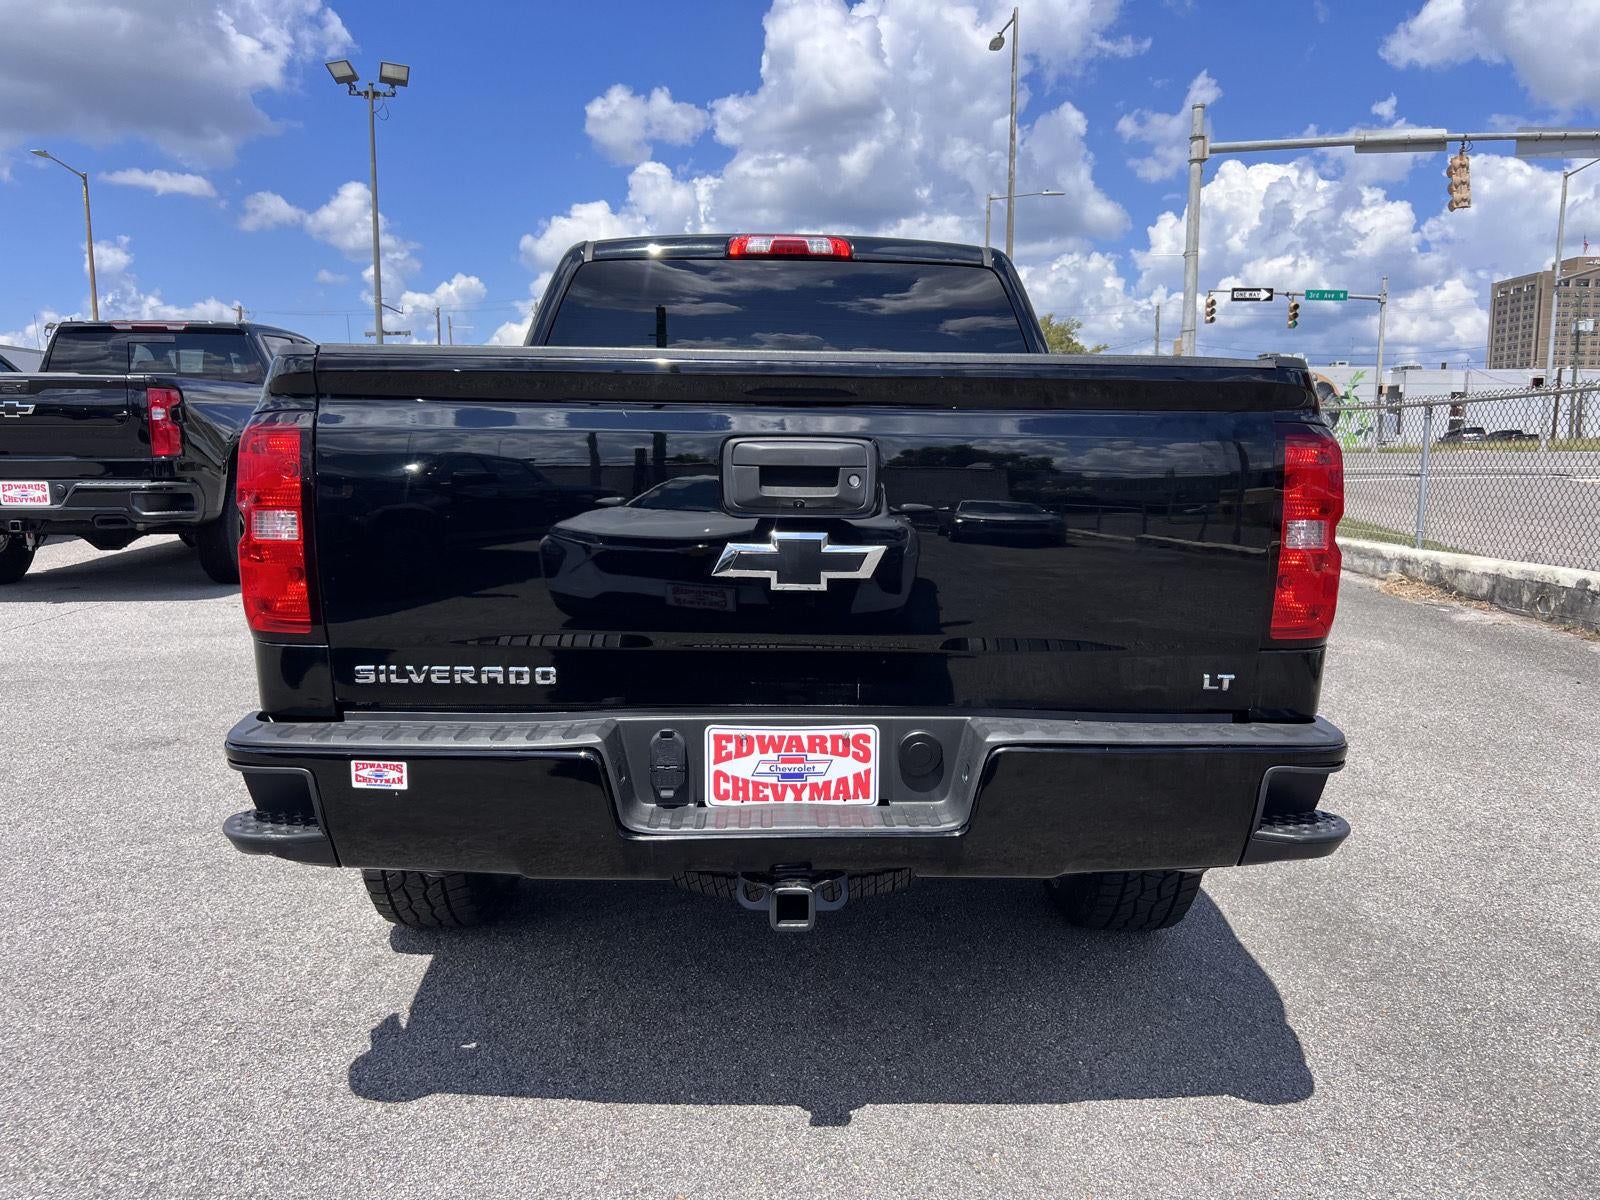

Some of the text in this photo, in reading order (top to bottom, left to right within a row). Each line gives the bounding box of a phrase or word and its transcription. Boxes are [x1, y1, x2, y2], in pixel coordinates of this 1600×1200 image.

[2, 483, 46, 493] EDWARDS
[2, 494, 48, 503] CHEVYMAN
[354, 665, 557, 685] SILVERADO
[1202, 673, 1236, 691] LT
[713, 734, 872, 765] EDWARDS
[354, 762, 404, 774] EDWARDS
[768, 764, 816, 772] Chevrolet
[354, 772, 404, 784] CHEVYMAN
[713, 768, 872, 802] CHEVYMAN
